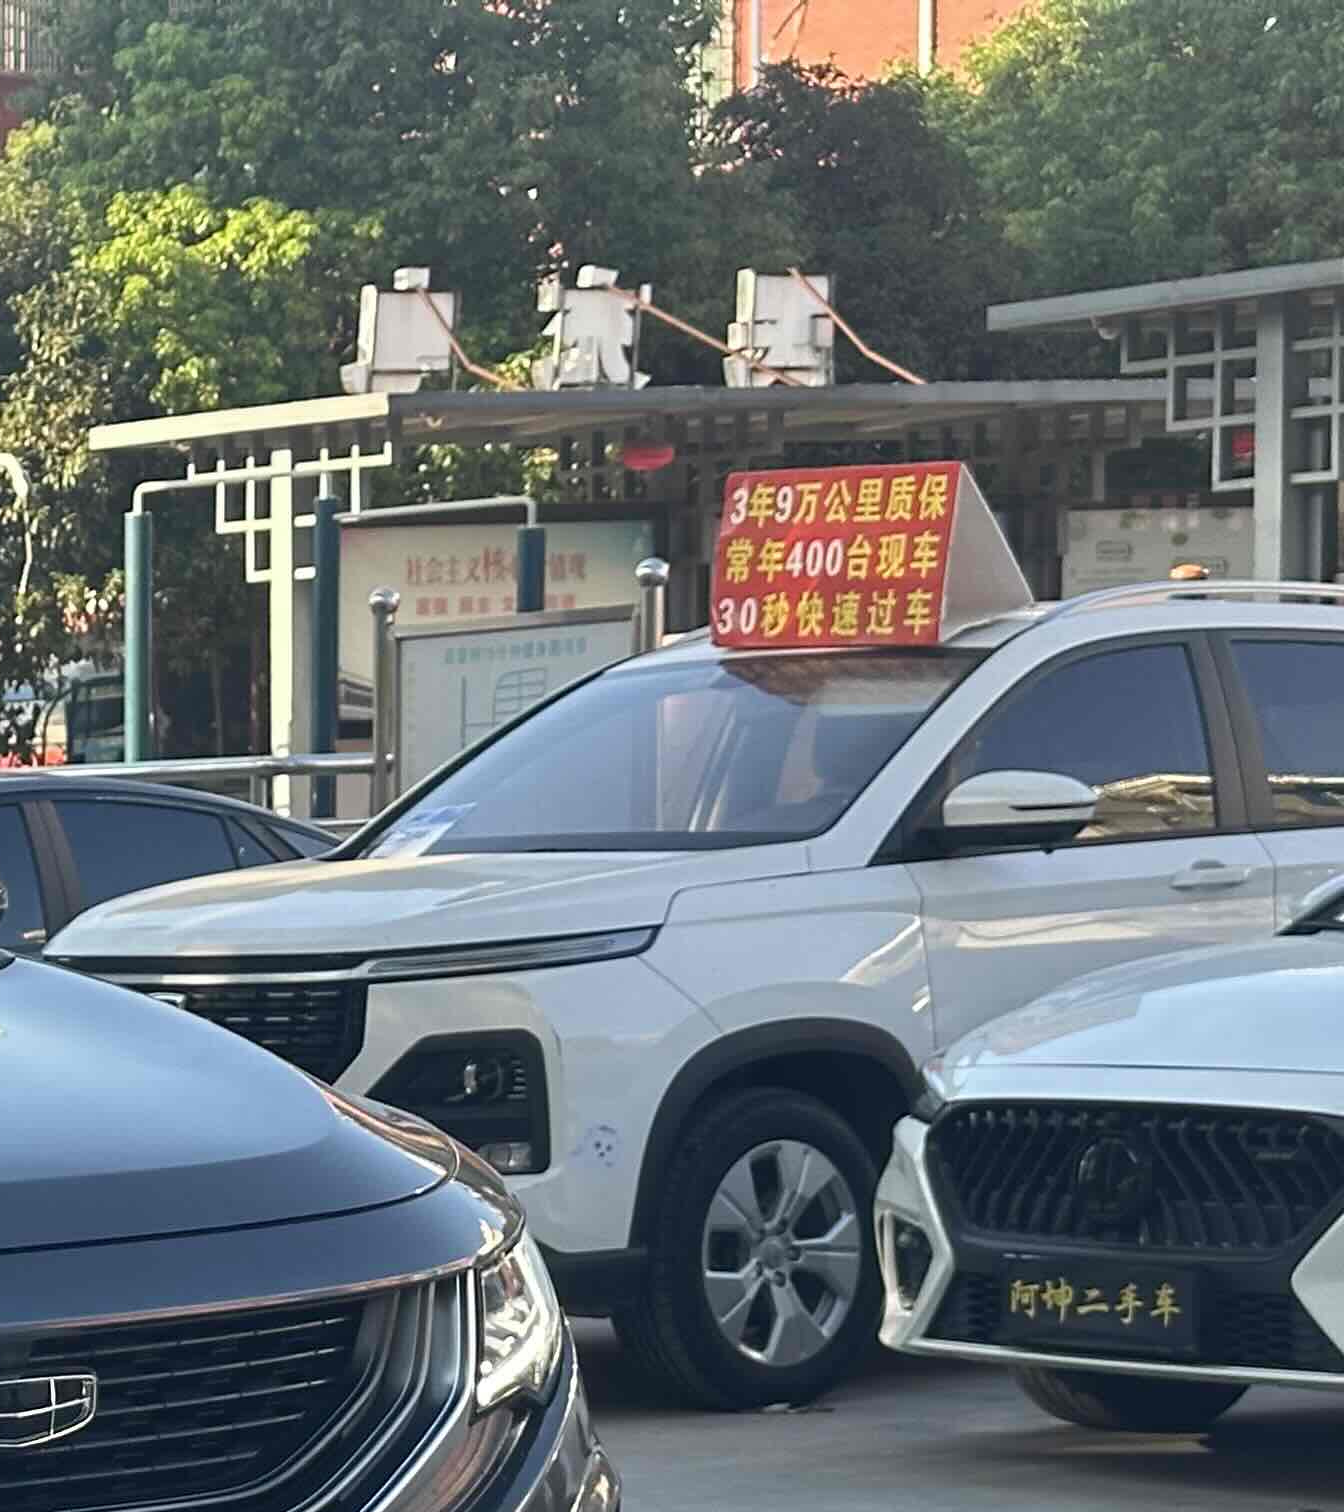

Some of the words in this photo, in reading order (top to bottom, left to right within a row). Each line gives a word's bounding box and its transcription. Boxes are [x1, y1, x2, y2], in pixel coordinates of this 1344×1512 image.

[728, 473, 949, 528] 3年9万公里质保
[405, 549, 587, 587] 社会主义核值观
[725, 529, 942, 583] 常年400台现车
[715, 587, 935, 638] 30秒快速过车
[1009, 1277, 1181, 1328] 阿坤二手车
